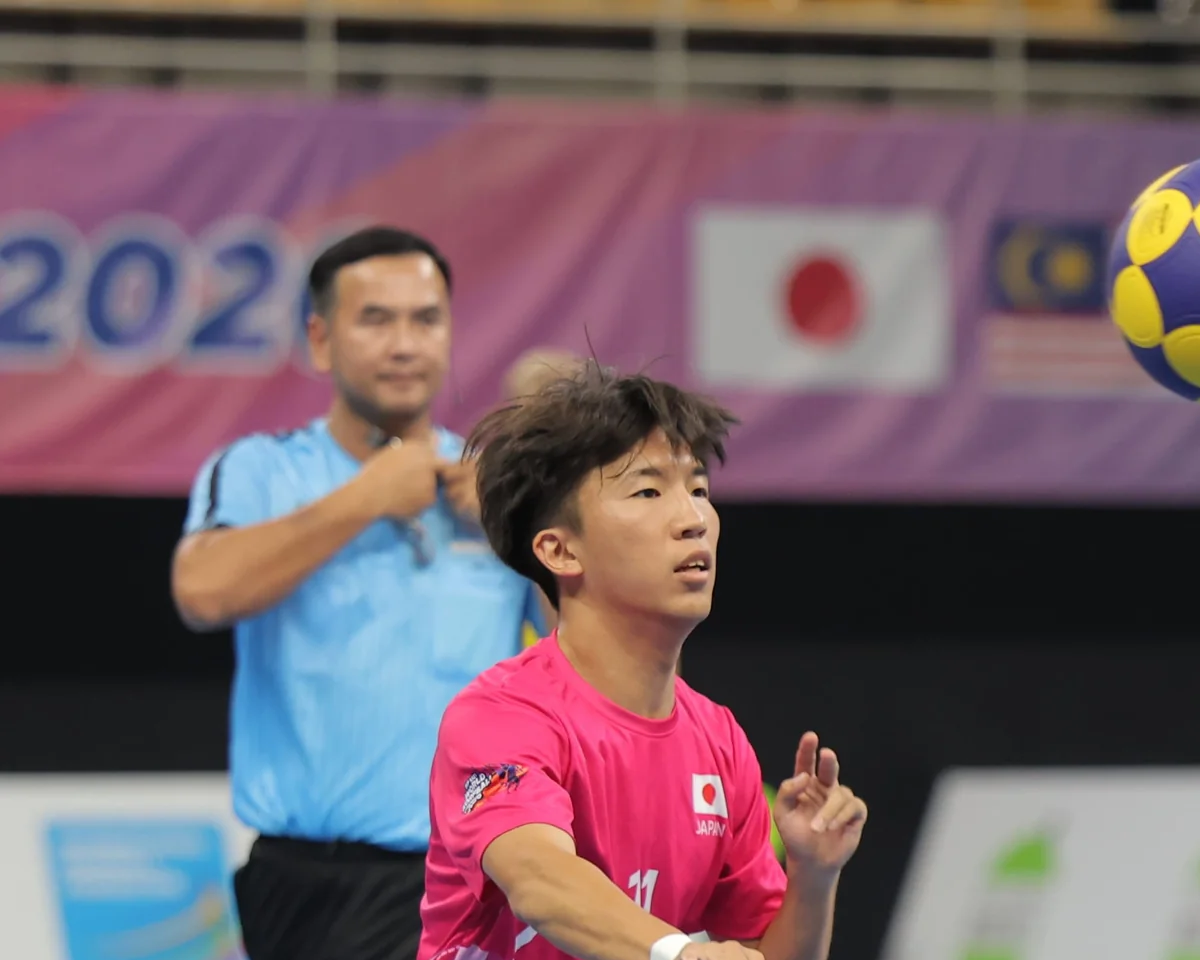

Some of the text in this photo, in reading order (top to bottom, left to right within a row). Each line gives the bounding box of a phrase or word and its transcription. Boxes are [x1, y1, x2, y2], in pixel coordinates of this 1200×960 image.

[0, 236, 313, 348] 202
[695, 819, 726, 838] JAPAN
[628, 868, 660, 914] 11
